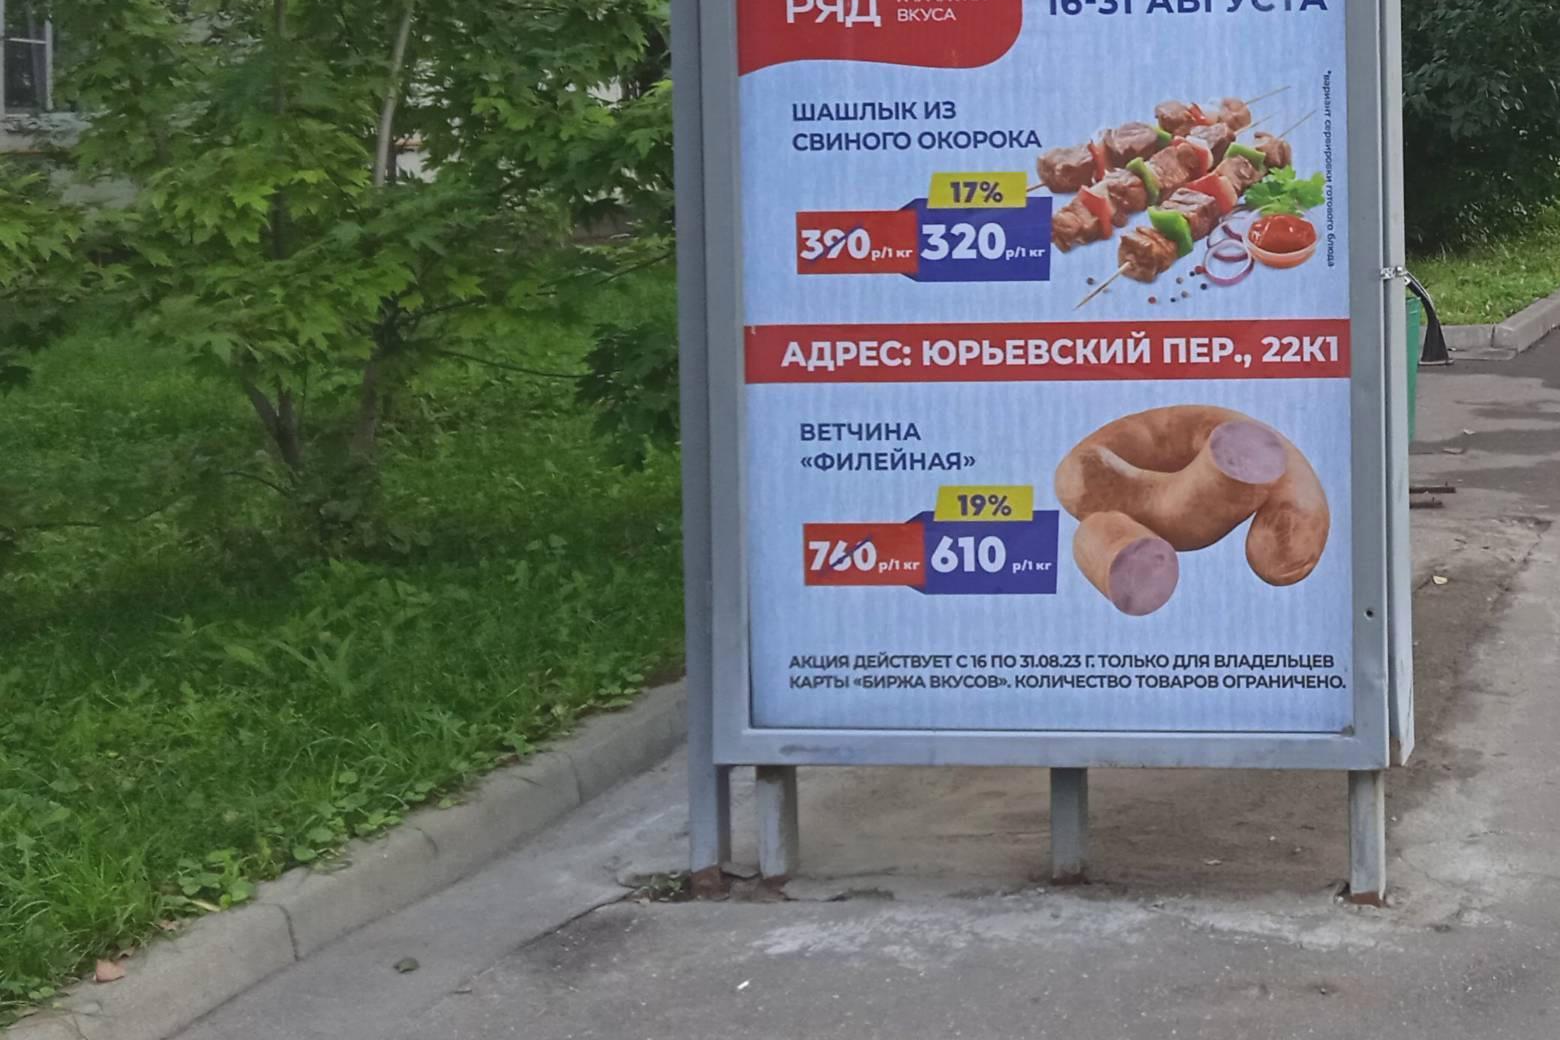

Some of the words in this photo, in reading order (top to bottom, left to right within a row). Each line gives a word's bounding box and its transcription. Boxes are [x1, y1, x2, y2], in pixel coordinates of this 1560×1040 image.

[897, 7, 957, 22] ВКУСА
[792, 101, 918, 122] ШАШЛЫК
[924, 100, 957, 120] ИЗ
[792, 132, 912, 152] СВИНОГО
[917, 129, 1043, 150] ОКОРОКА
[950, 180, 1004, 204] 17%
[800, 227, 871, 261] 390
[895, 248, 913, 258] кг
[920, 222, 1006, 261] 320
[1029, 247, 1046, 258] кг
[781, 340, 912, 372] АДРЕС:
[922, 331, 1151, 367] ЮРЬЕВСКИЙ
[1163, 337, 1252, 368] ПЕР.,
[1261, 335, 1339, 363] 22К1
[800, 422, 922, 442] ВЕТЧИНА
[800, 448, 976, 472] «ФИЛЕЙНАЯ»
[957, 494, 1013, 517] 19%
[808, 539, 878, 573] 760
[903, 561, 921, 571] кг
[931, 535, 1007, 573] 610
[1036, 561, 1052, 571] кг
[789, 655, 850, 671] АКЦИЯ
[853, 652, 953, 671] ДЕЙСТВУЕТ
[956, 655, 968, 669] С
[970, 655, 988, 669] 16
[991, 655, 1017, 669] ПО
[1020, 654, 1082, 669] 31.08.23
[1085, 654, 1095, 669] Г.
[1097, 654, 1169, 669] ТОЛЬКО
[1172, 654, 1210, 671] ДЛЯ
[1214, 654, 1335, 671] ВЛАДЕЛЬЦЕВ
[789, 675, 850, 689] КАРТЫ
[853, 675, 927, 689] «БИРЖА
[929, 675, 1012, 689] ВКУСОВ».
[1015, 675, 1132, 689] КОЛИЧЕСТВО
[1135, 675, 1219, 689] ТОВАРОВ
[1222, 674, 1347, 689] ОГРАНИЧЕНО.
